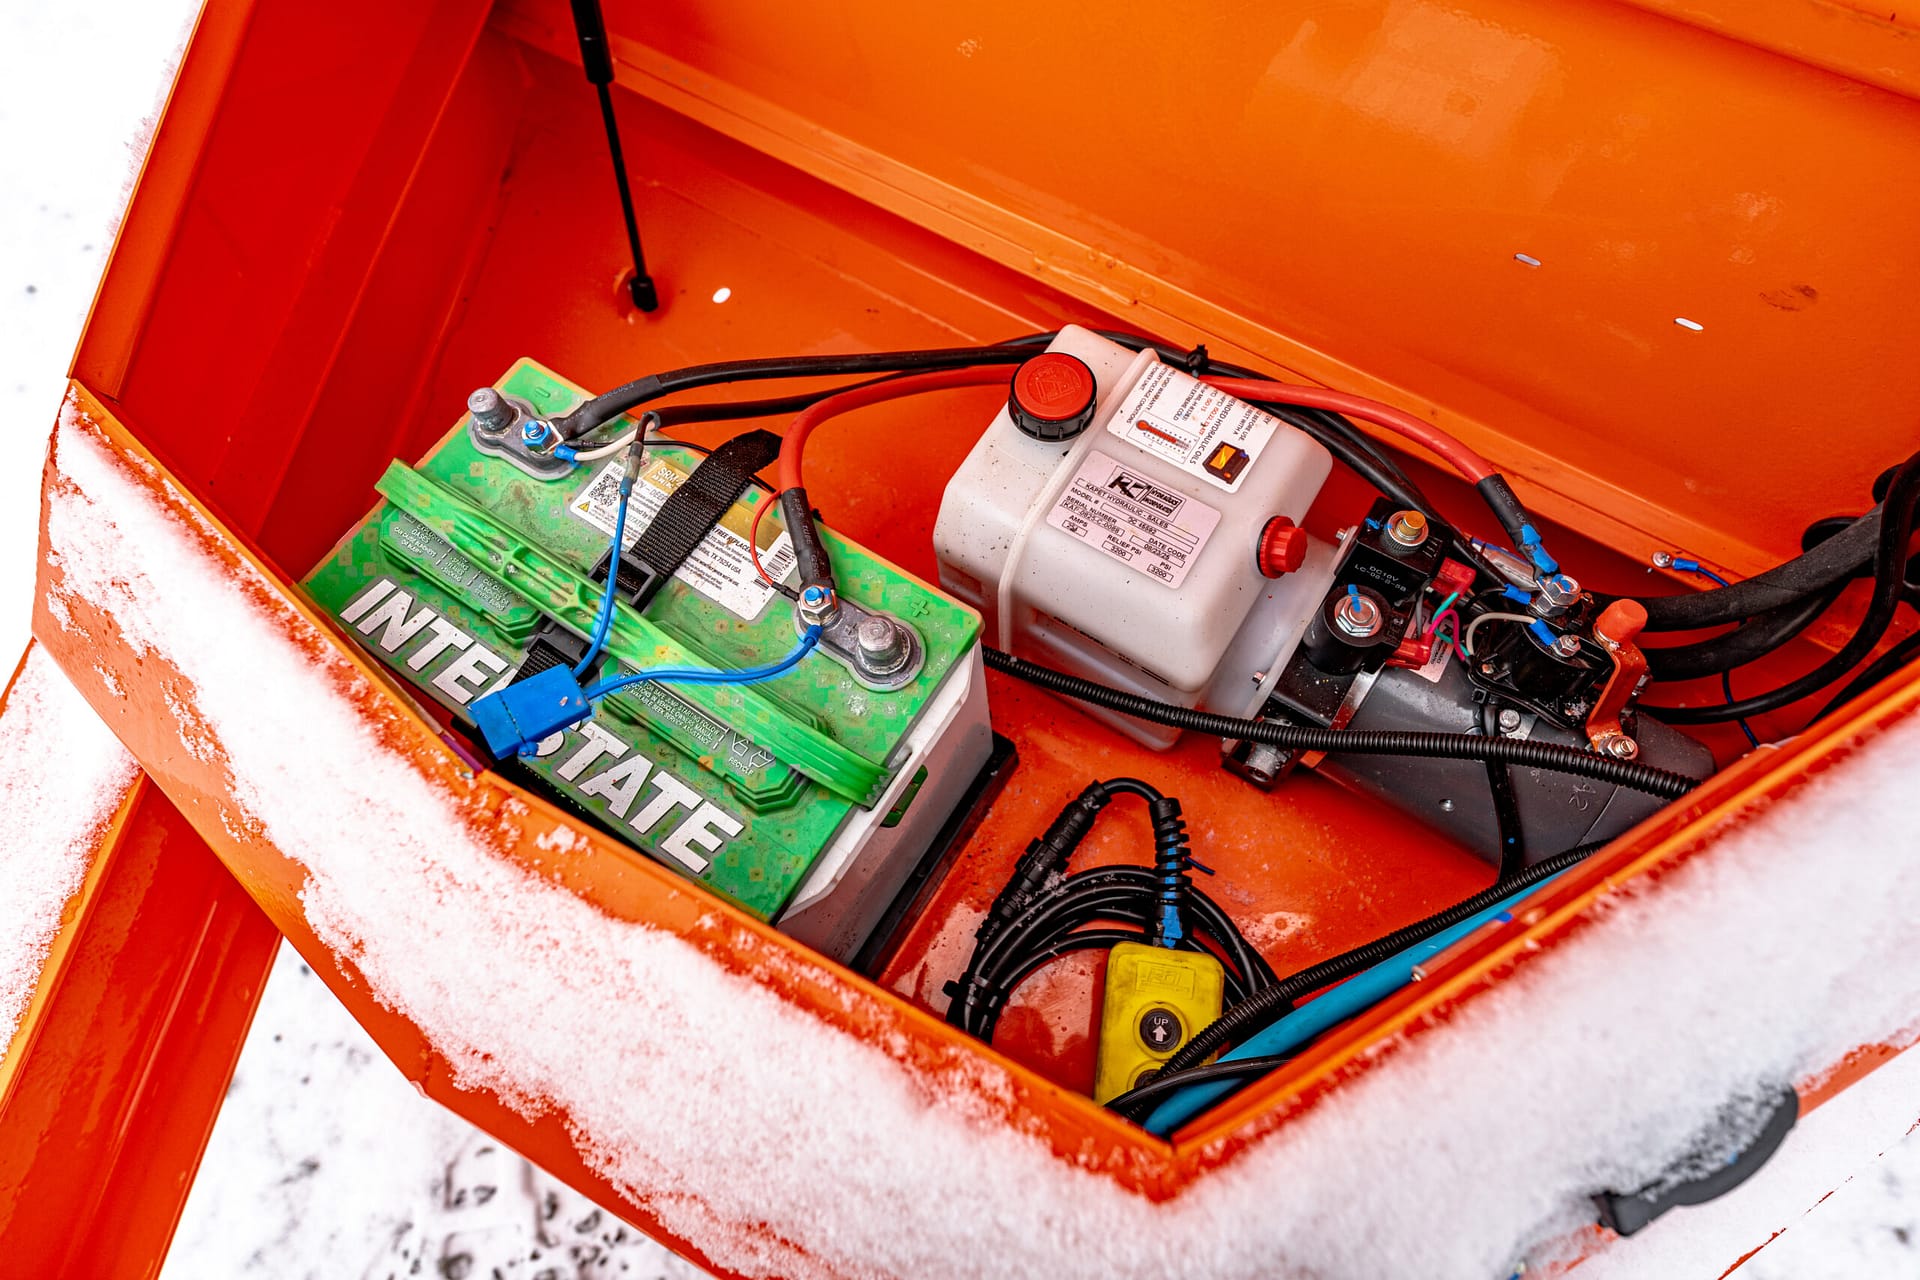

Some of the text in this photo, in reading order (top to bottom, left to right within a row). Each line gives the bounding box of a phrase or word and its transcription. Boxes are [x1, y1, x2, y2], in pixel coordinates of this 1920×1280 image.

[1145, 365, 1159, 382] POWER
[1143, 379, 1158, 399] VOLTAGE
[1145, 386, 1163, 411] WARRANTY
[1125, 396, 1146, 425] CONDITIONS
[1172, 388, 1196, 421] EXTREME COLD
[1197, 416, 1222, 452] HYDRAULIC
[1235, 417, 1246, 432] WITH
[1188, 449, 1202, 466] OILS
[656, 465, 686, 488] SRM-2
[1069, 486, 1094, 502] MODEL
[1065, 494, 1117, 525] SERIAL NUMBER
[1084, 482, 1106, 497] KAPET
[1106, 493, 1143, 516] HYDRAULIC
[1146, 513, 1169, 529] SALES
[1068, 514, 1088, 528] AMPS
[410, 527, 431, 544] GASES
[714, 527, 728, 539] FREE
[1106, 534, 1142, 556] RELIEF PSI
[1148, 537, 1187, 560] DATE CODE
[709, 552, 718, 560] TX
[716, 556, 732, 569] 75254
[730, 565, 741, 574] USA
[1159, 561, 1171, 571] PSI
[629, 688, 653, 707] AVAILABLE
[651, 703, 665, 715] SEEK
[663, 711, 683, 727] SERVICE
[682, 724, 711, 746] ASSISTANCE
[652, 688, 666, 700] SAFE
[664, 696, 678, 708] JUMP
[676, 705, 701, 723] STARTING
[699, 719, 720, 736] FOLLOW
[655, 698, 675, 714] VEHICLE
[339, 578, 745, 875] INTETATE
[726, 756, 755, 777] RECYCLE
[1153, 1017, 1168, 1026] UP
